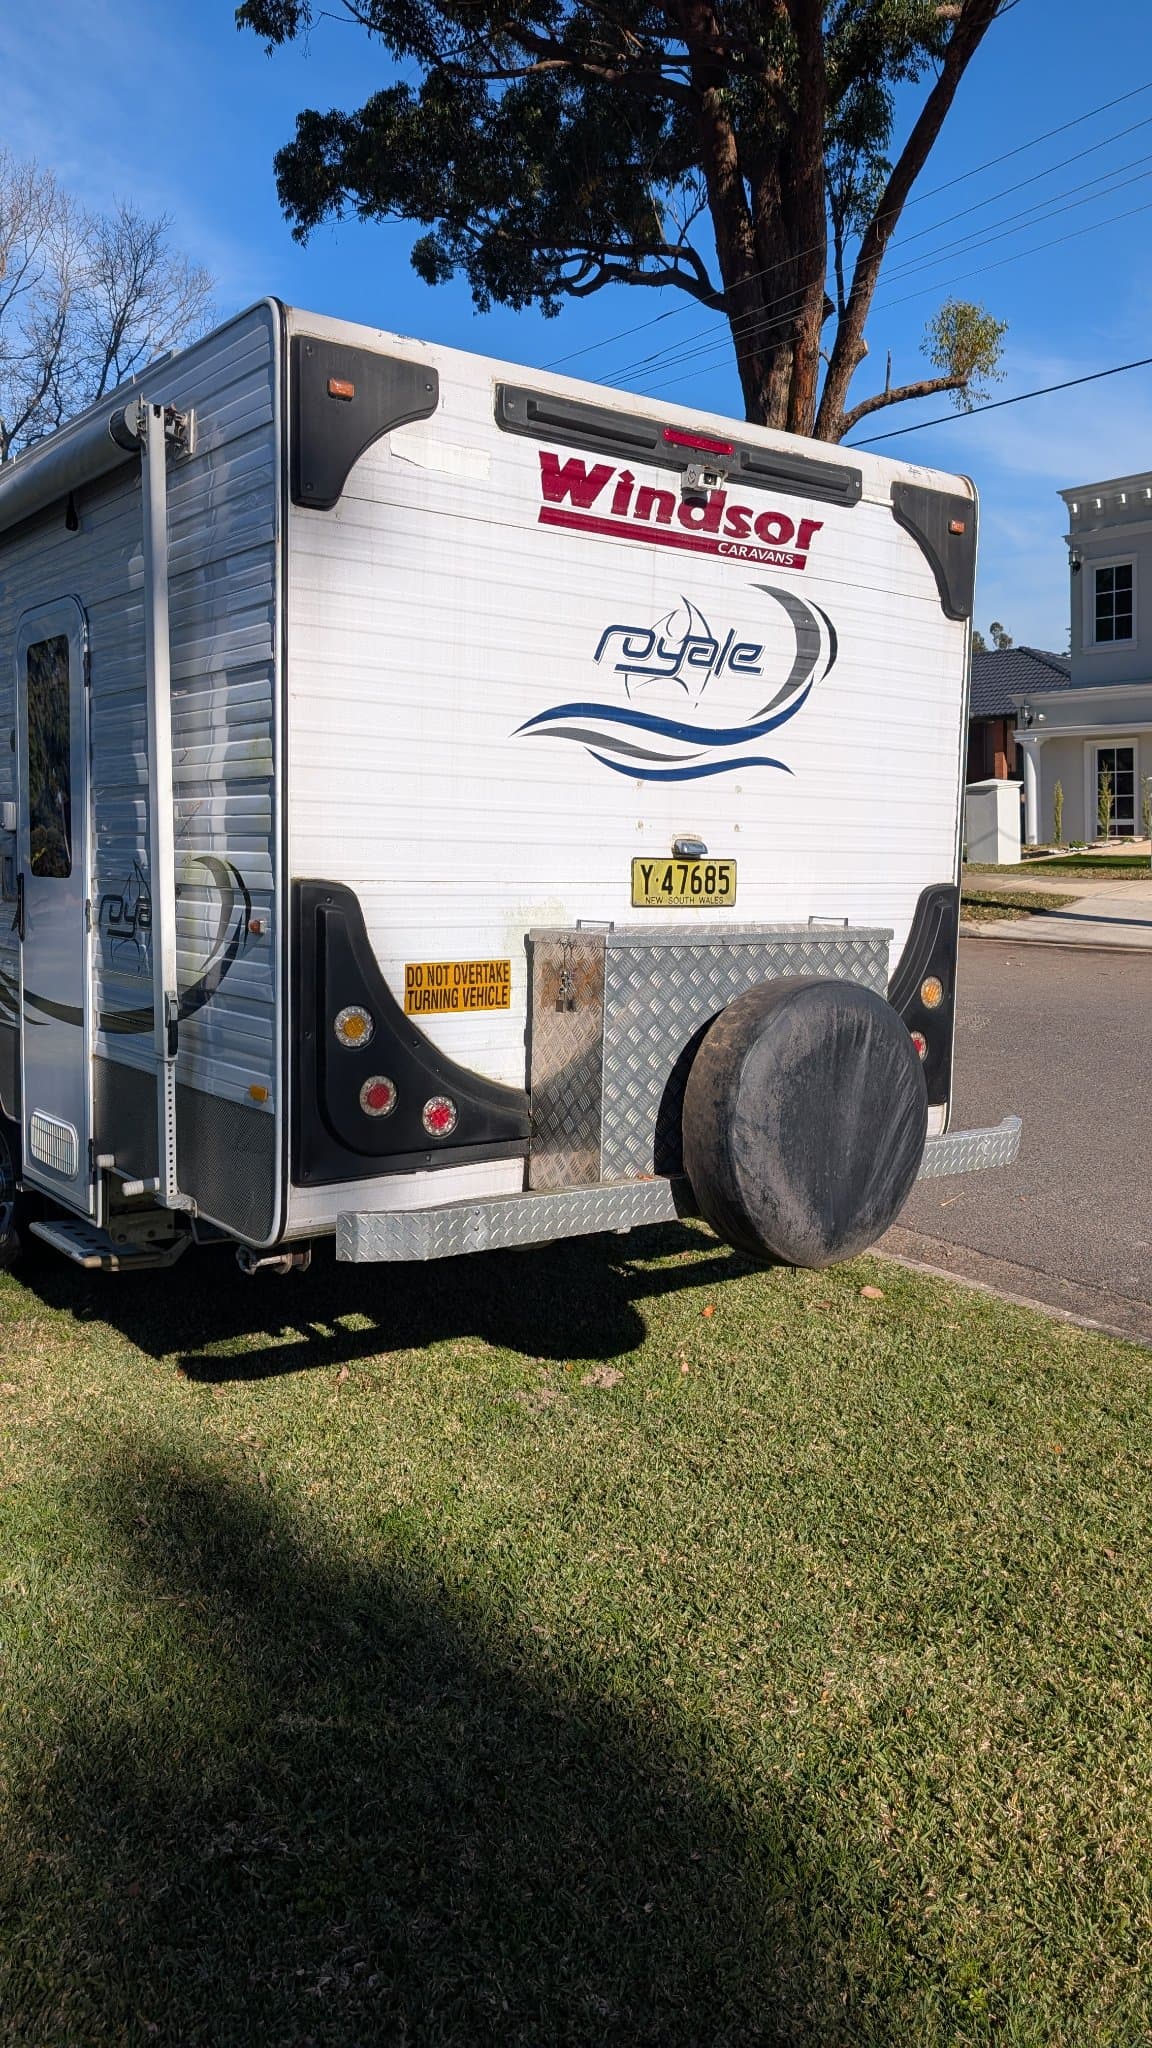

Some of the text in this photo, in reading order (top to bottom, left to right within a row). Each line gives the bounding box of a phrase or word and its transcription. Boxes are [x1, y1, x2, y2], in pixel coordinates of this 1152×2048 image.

[538, 450, 824, 551] Windsor
[718, 542, 794, 565] CARAVANS
[592, 625, 765, 678] royale
[645, 896, 724, 905] NEW SOUTH WALES
[406, 963, 509, 987] DO NOT OVERTAKE
[407, 985, 508, 1011] TURNING VEHICLE
